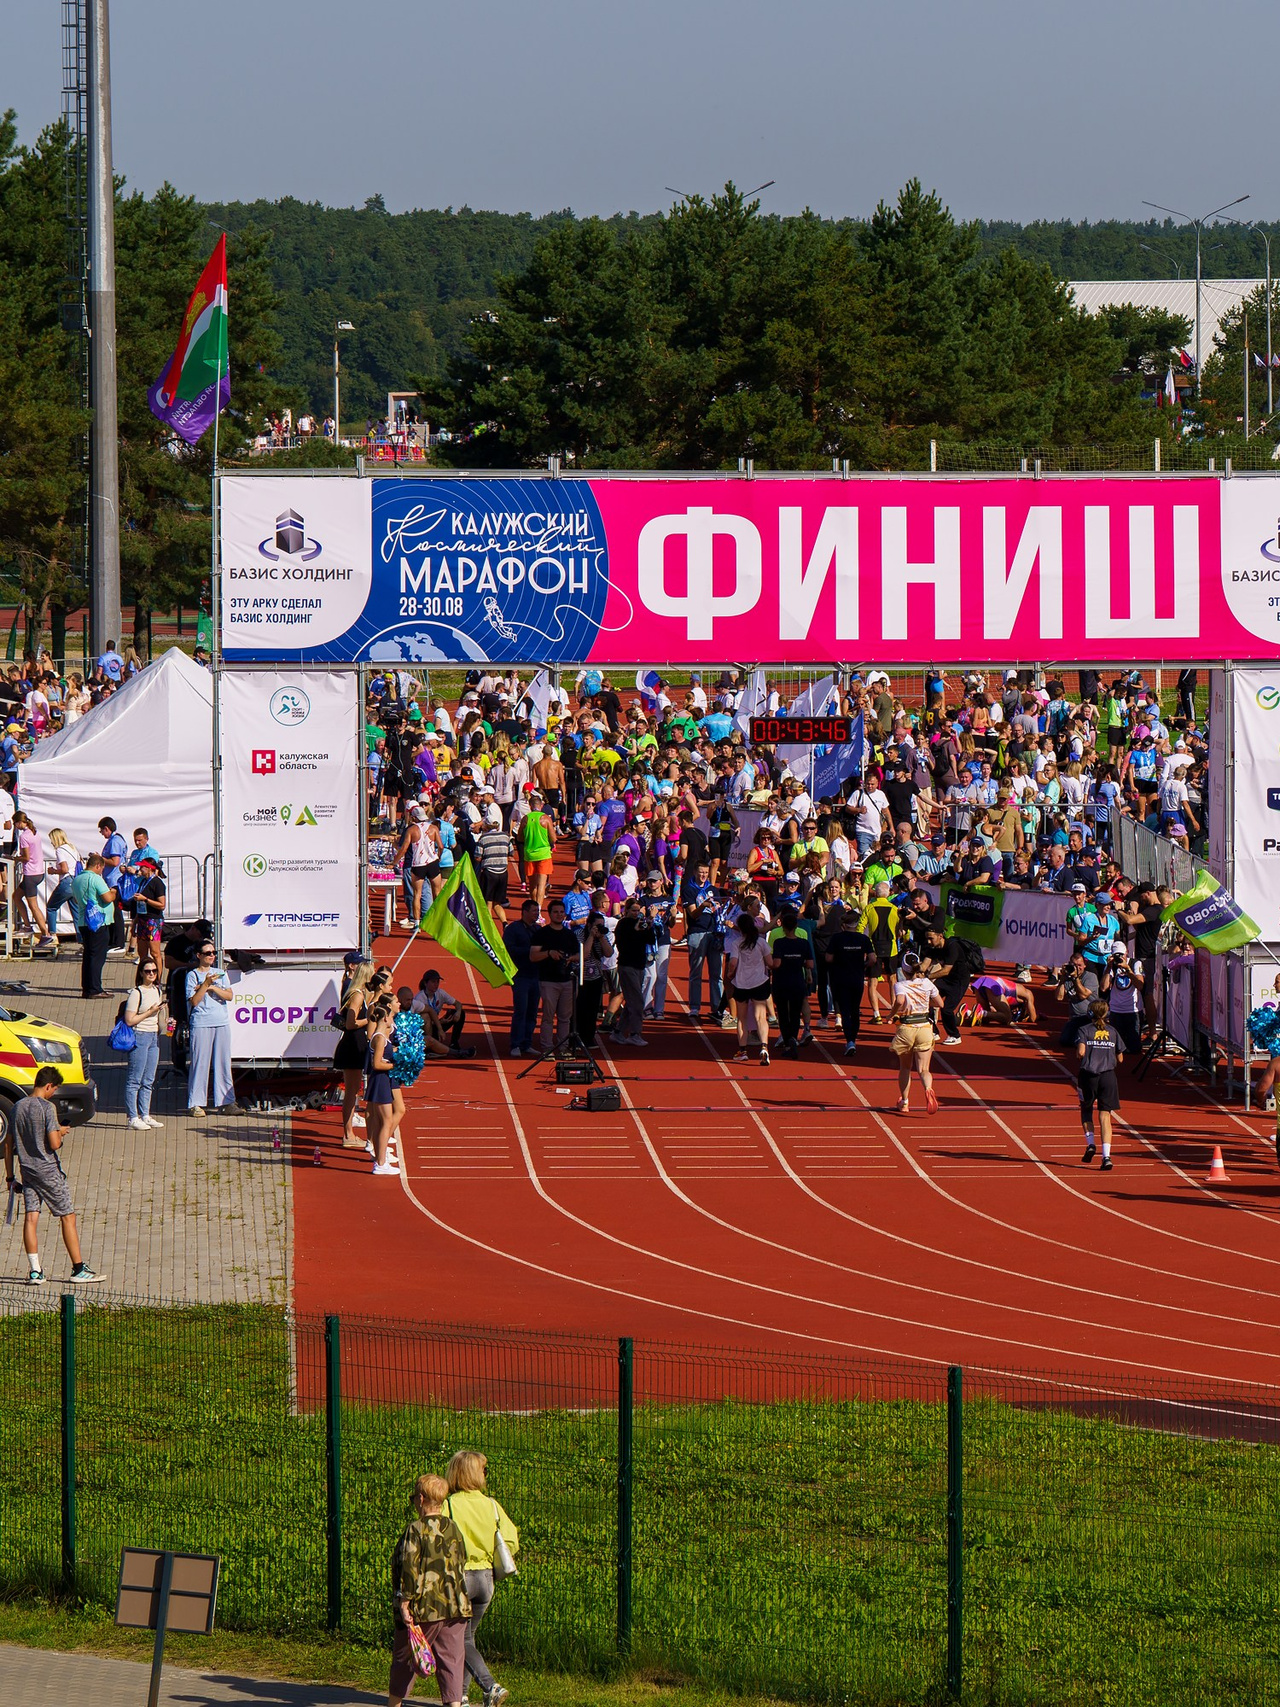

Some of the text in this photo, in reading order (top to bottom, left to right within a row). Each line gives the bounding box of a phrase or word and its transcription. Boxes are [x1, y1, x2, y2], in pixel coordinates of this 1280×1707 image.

[451, 509, 589, 537] КАЛУЖСКИЙ
[229, 567, 354, 583] БАЗИС ХОЛДИНГ
[400, 556, 589, 594] МАРАФОН
[637, 505, 1200, 640] ФИНИШ
[1231, 569, 1280, 582] БАЗИС
[230, 598, 322, 610] ЭТУ АРКУ СДЕЛАЛ
[399, 597, 463, 617] 28-30.08
[230, 612, 313, 625] БАЗИС ХОЛДИНГ
[753, 720, 847, 742] 00:43:46
[279, 753, 329, 762] калужская
[279, 762, 318, 770] область
[257, 806, 278, 814] мой
[242, 812, 278, 822] бизнес
[264, 913, 340, 922] TRANSOFF
[234, 994, 266, 1005] PRO
[1260, 988, 1278, 999] PR
[234, 1006, 337, 1024] СПОРТ 4
